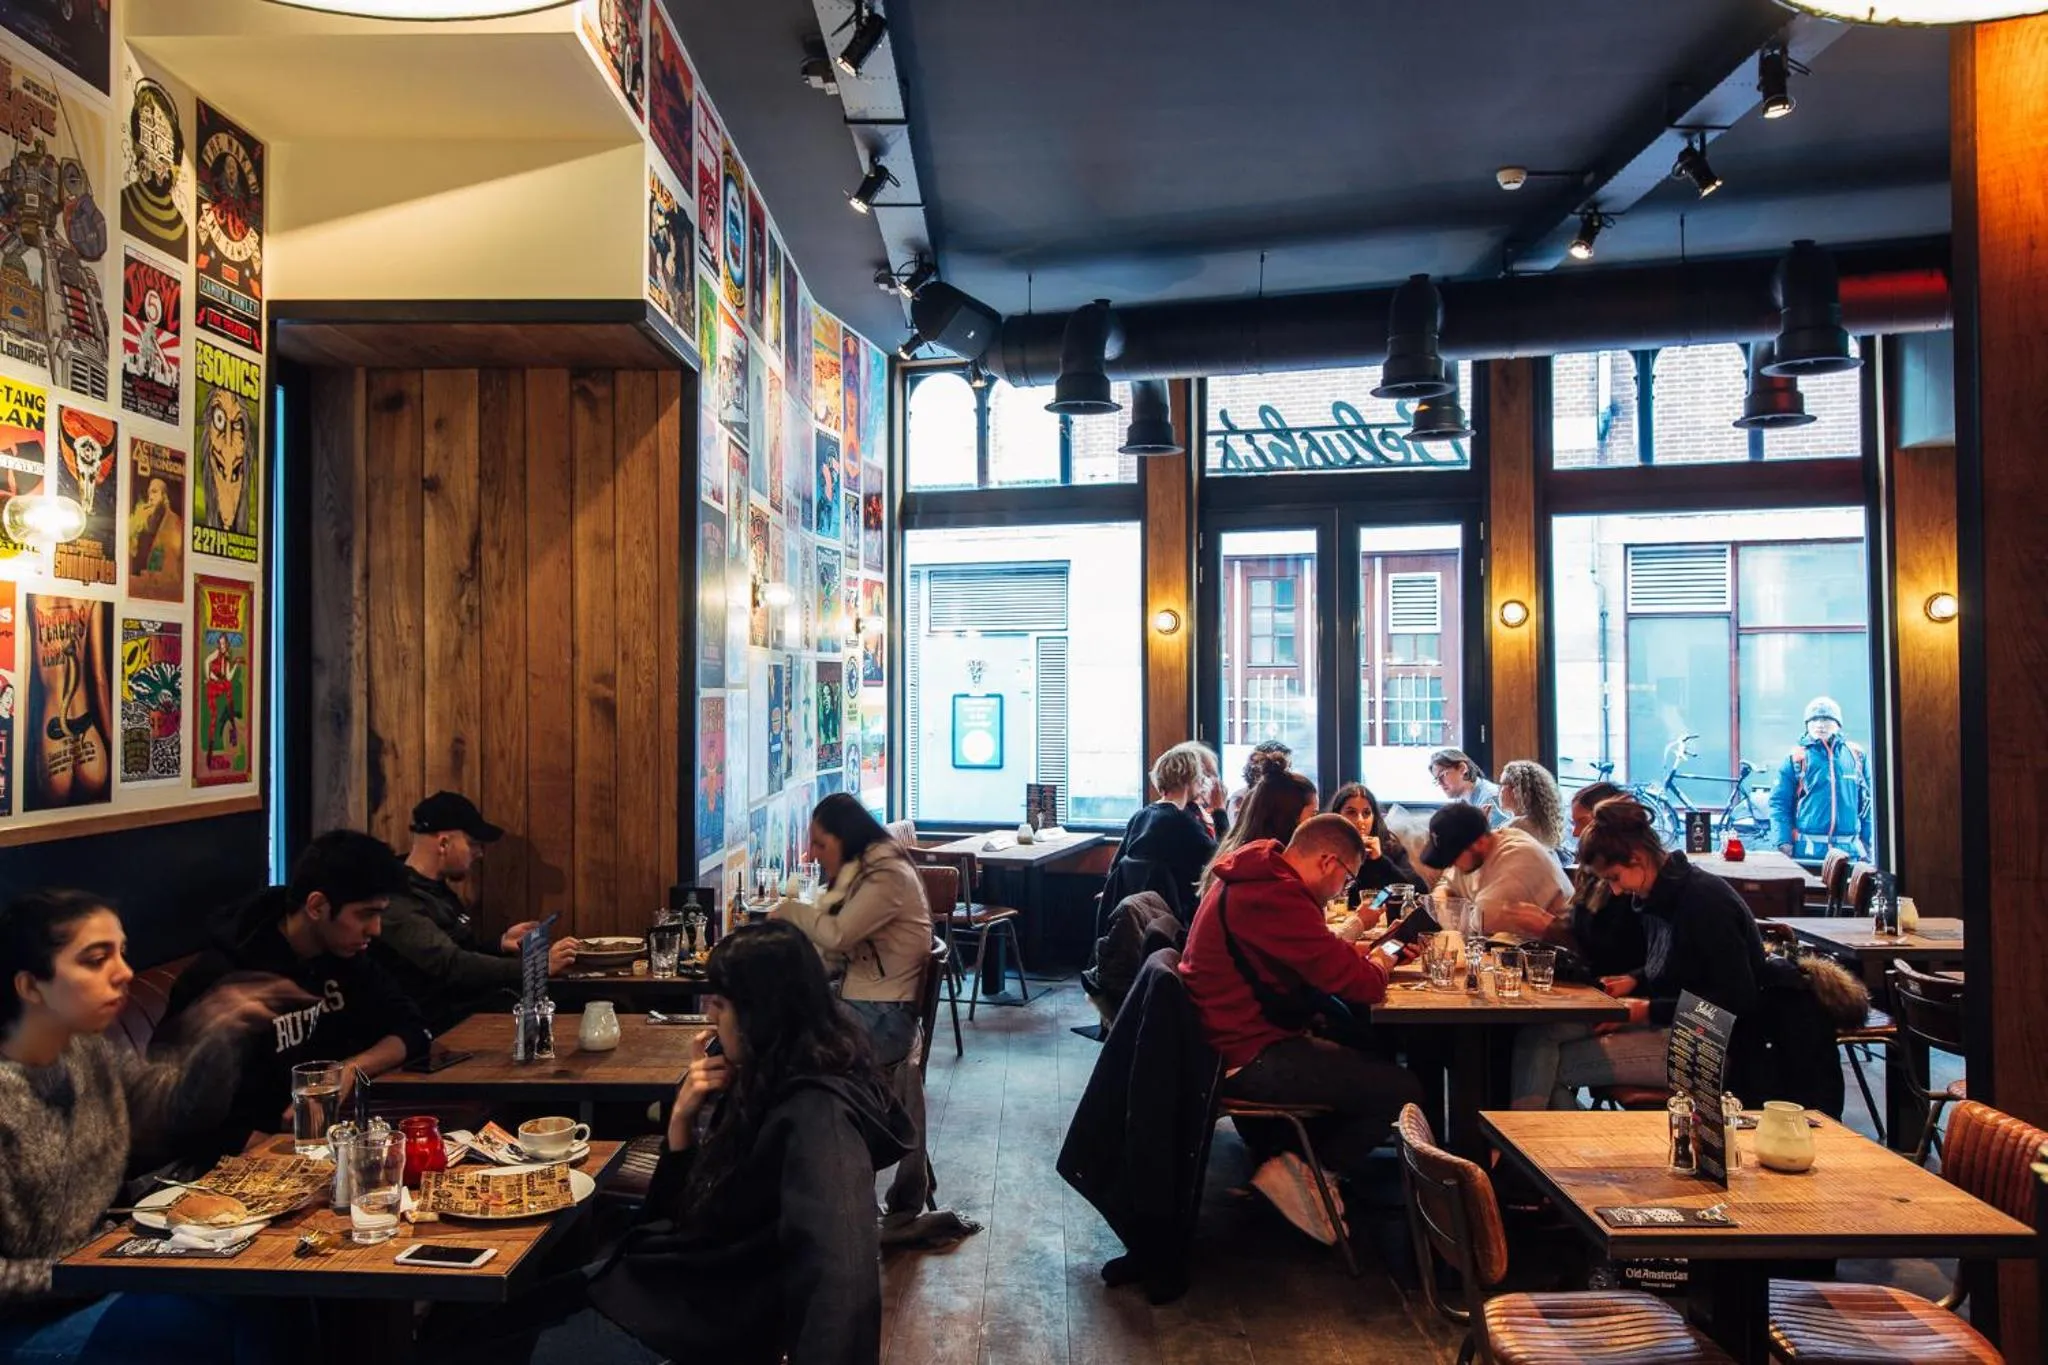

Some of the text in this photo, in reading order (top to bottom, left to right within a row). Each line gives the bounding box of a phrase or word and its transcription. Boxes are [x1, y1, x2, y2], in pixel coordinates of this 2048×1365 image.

[147, 293, 159, 321] 5
[203, 345, 259, 400] SONICS
[1625, 1267, 1642, 1279] Old
